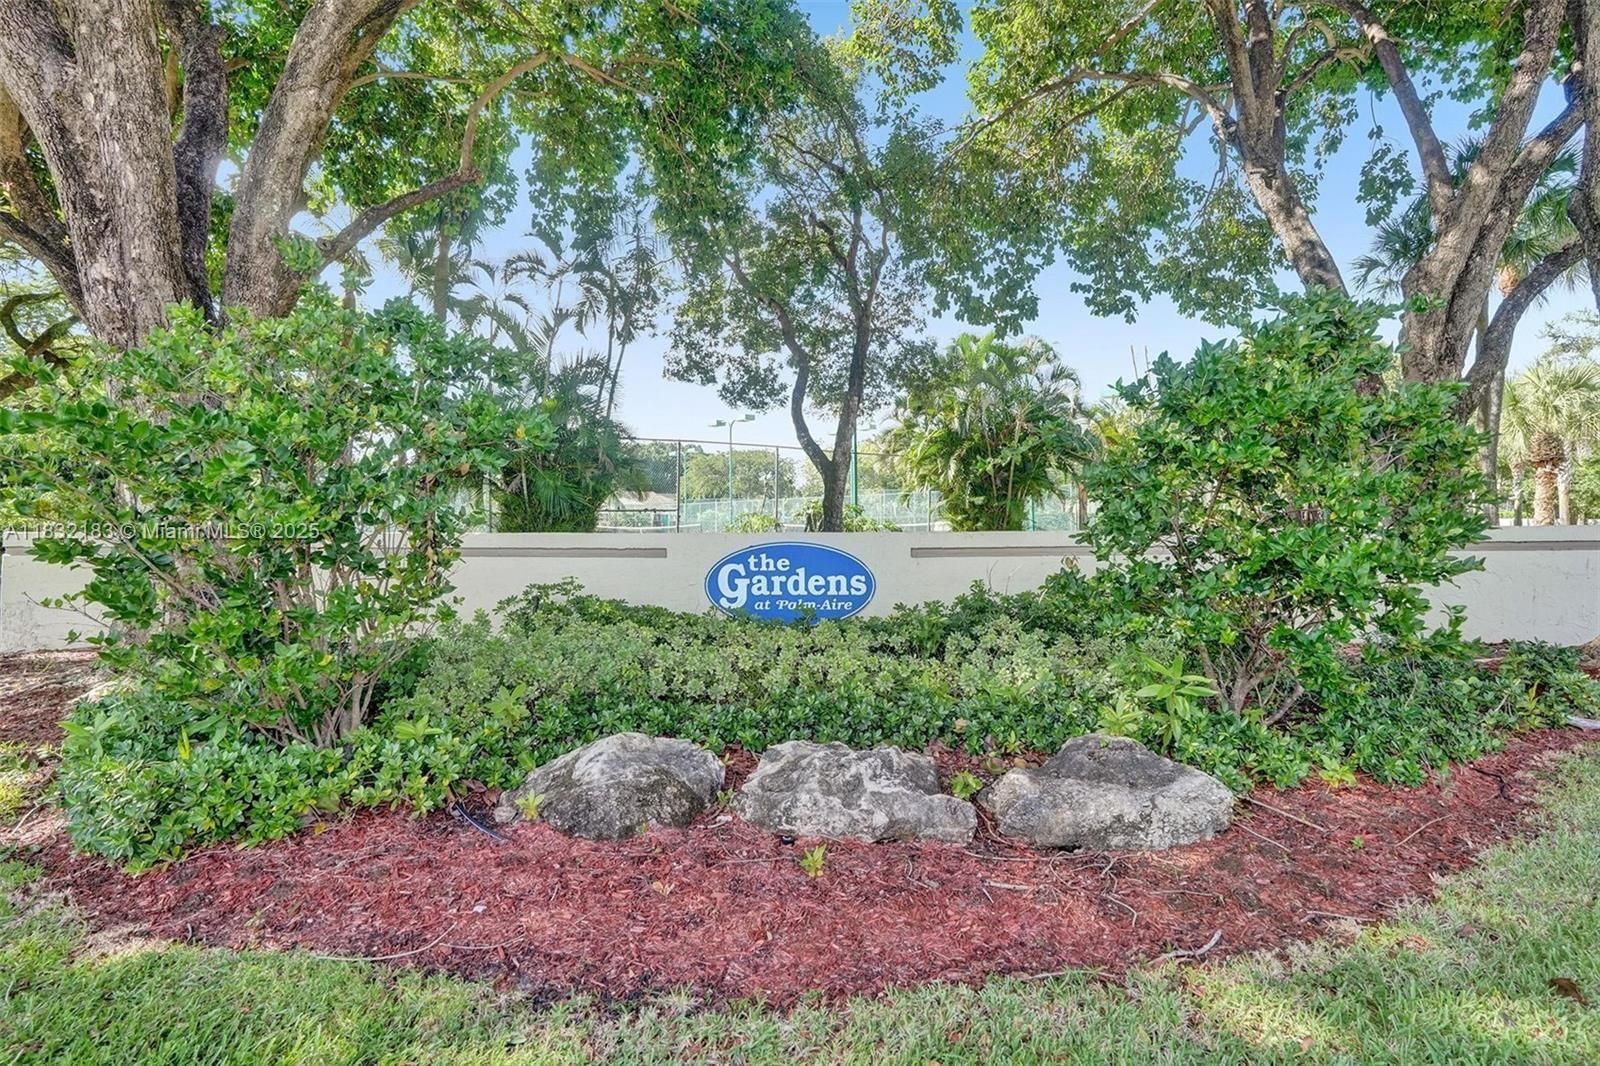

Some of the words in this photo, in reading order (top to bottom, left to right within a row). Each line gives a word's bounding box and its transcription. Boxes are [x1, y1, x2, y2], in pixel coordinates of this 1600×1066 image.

[747, 553, 791, 572] the
[717, 562, 868, 609] Gardens
[754, 599, 771, 610] at
